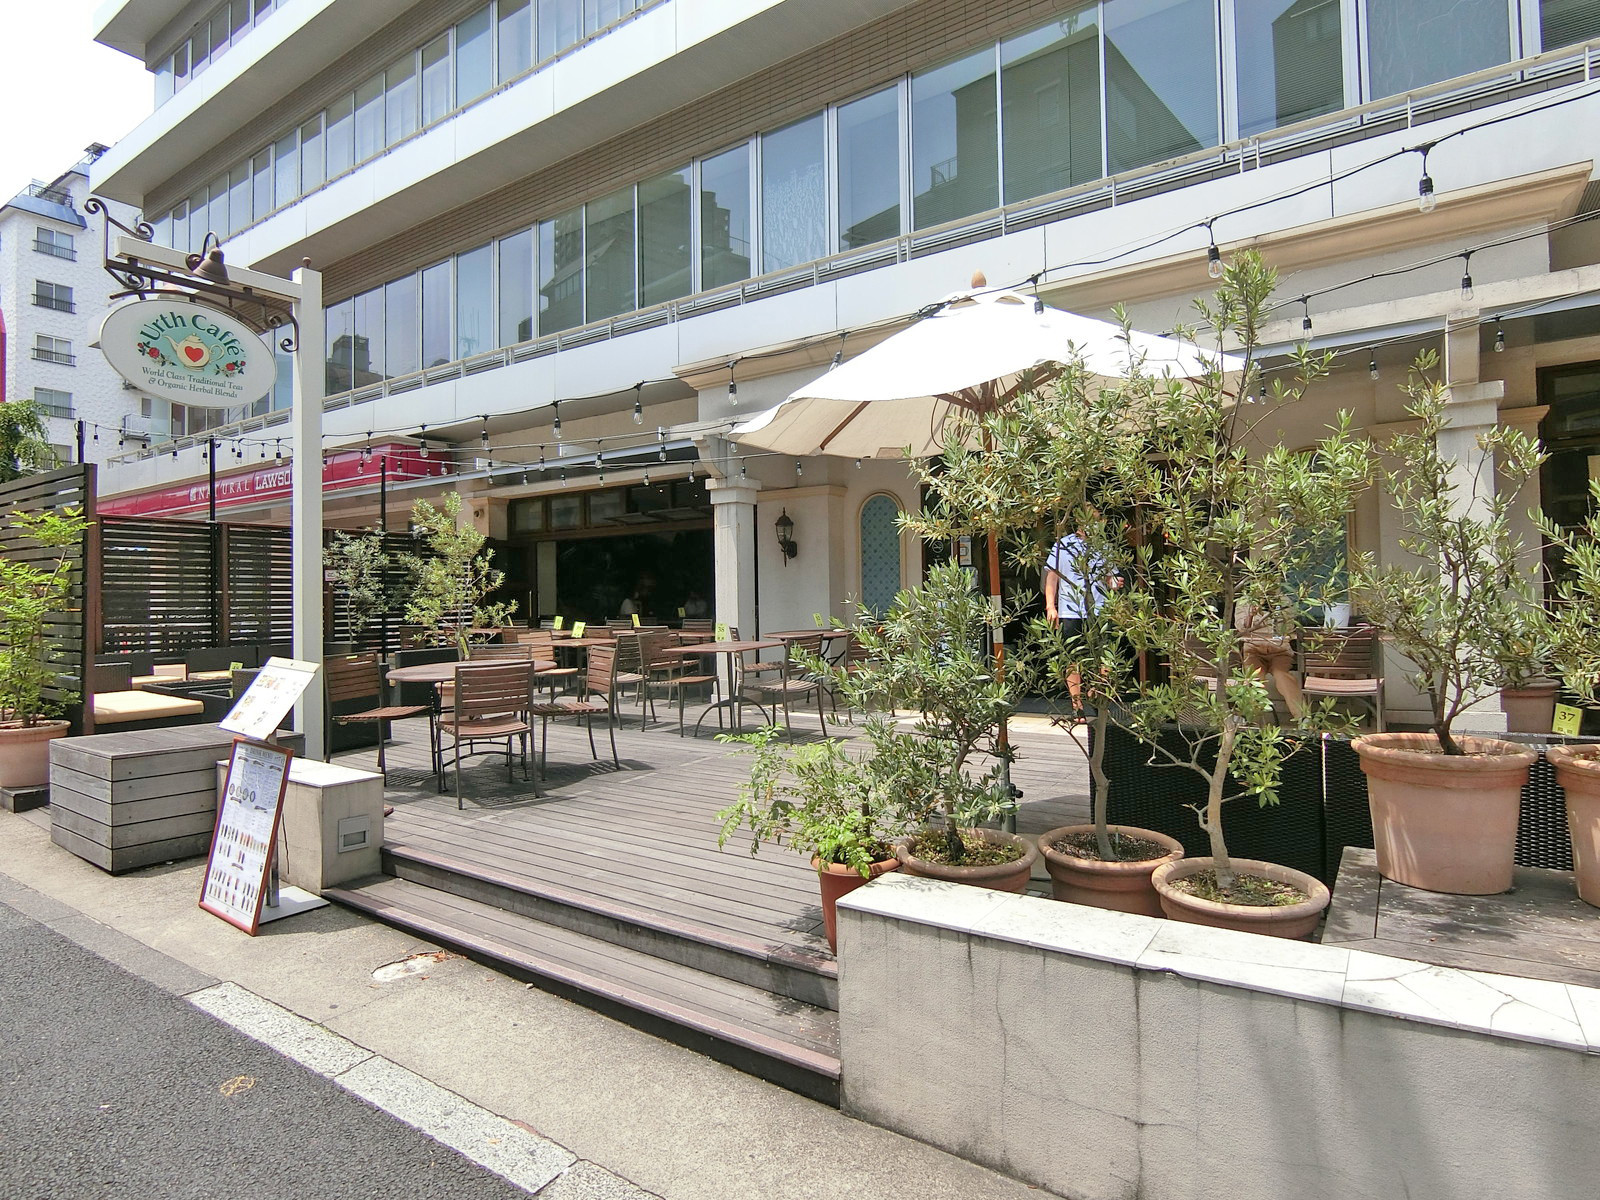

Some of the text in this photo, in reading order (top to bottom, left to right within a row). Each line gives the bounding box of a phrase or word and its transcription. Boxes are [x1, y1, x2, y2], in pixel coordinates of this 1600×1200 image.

[140, 312, 245, 356] Urth Caffé
[142, 366, 243, 391] World Class Traditional Teas
[148, 377, 238, 398] & Organic Herbal Blends
[255, 469, 291, 490] LAWSO
[1558, 711, 1576, 722] 37
